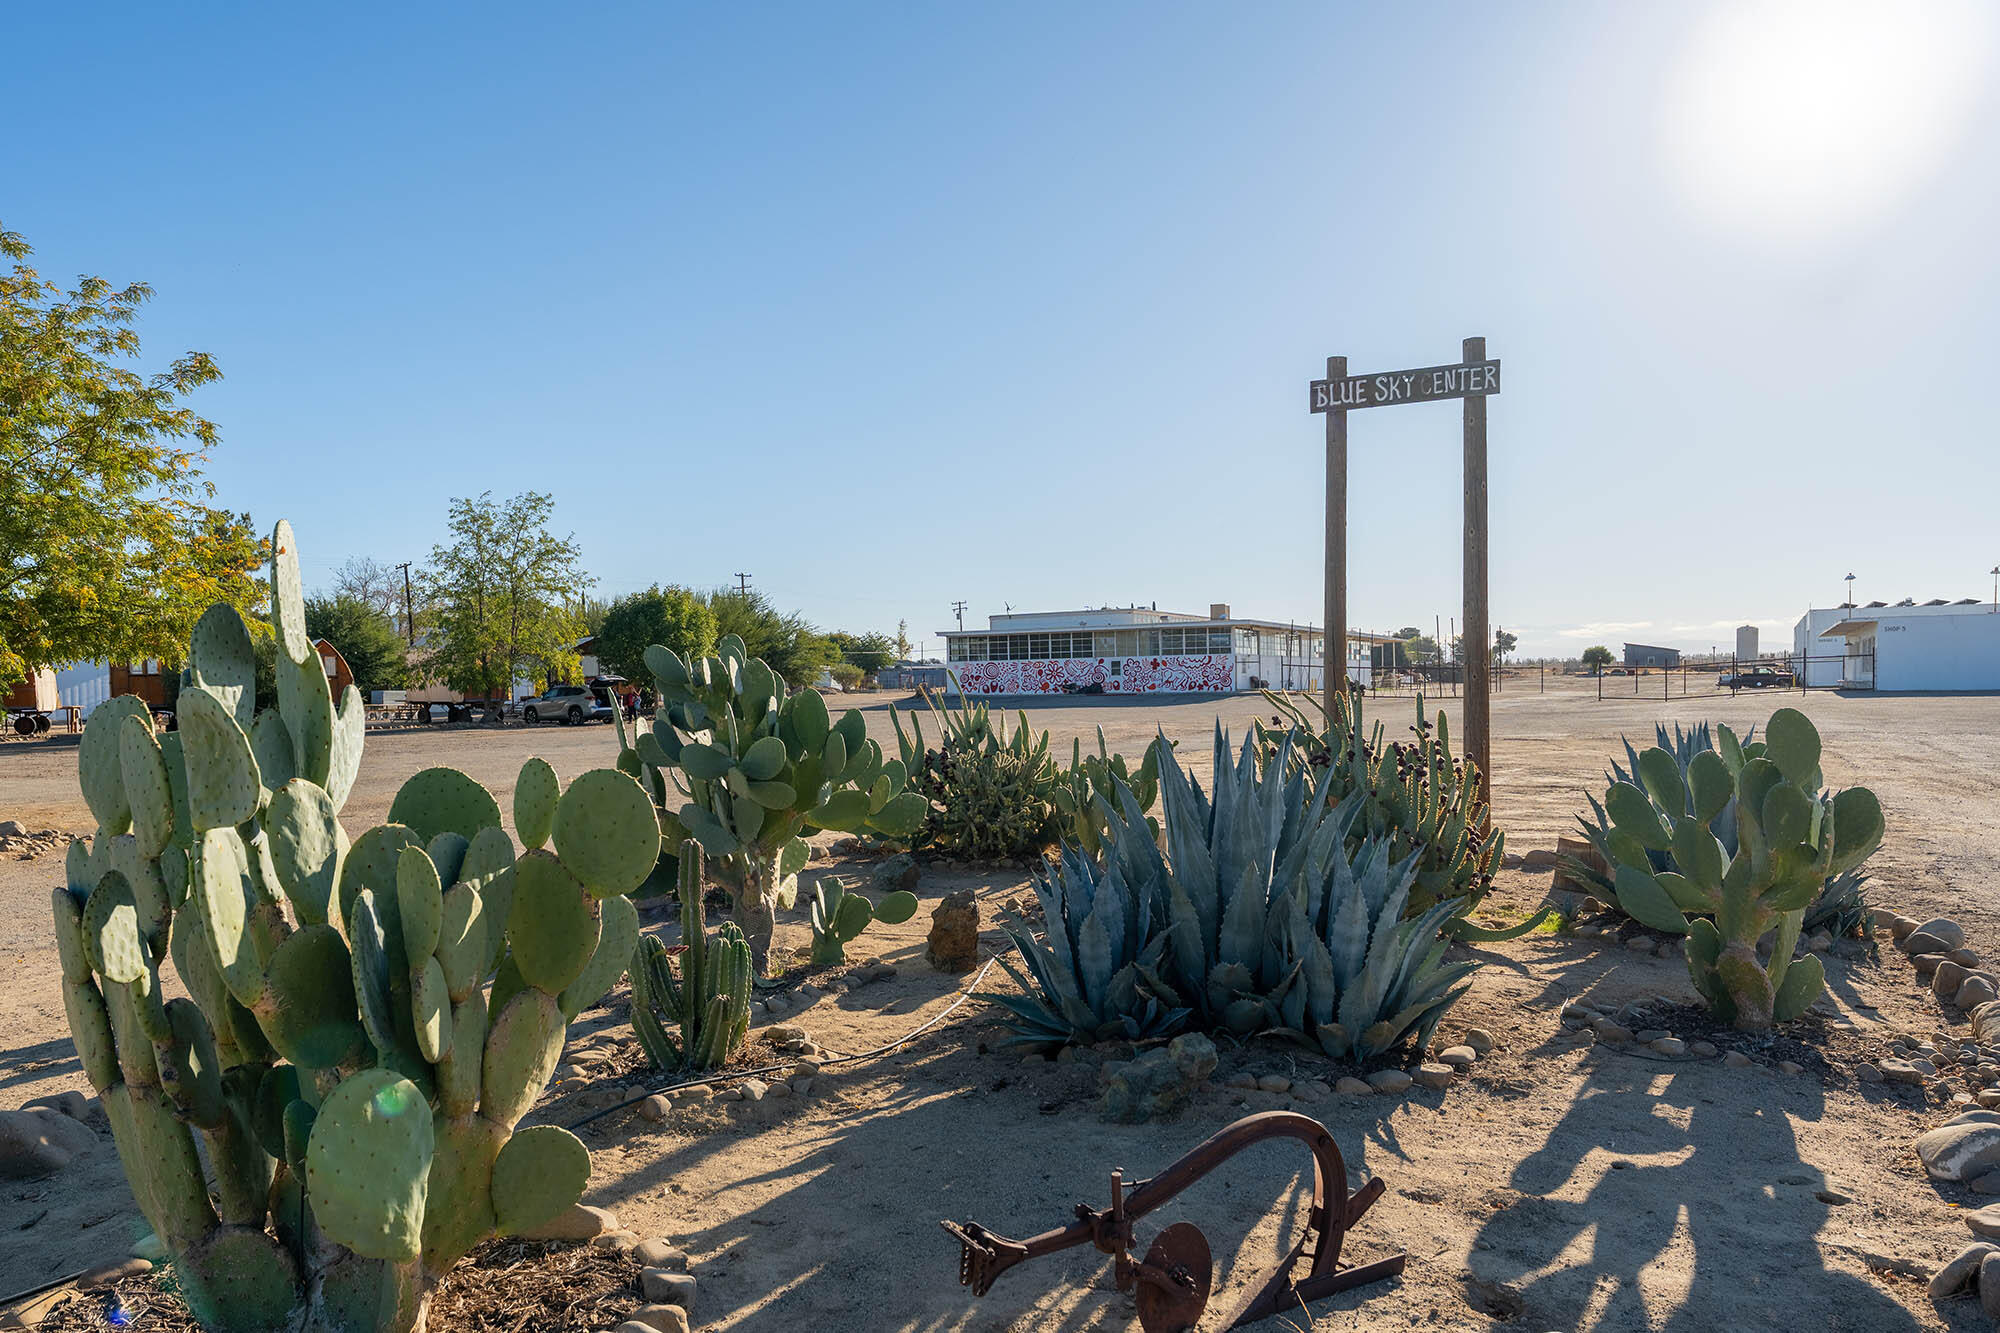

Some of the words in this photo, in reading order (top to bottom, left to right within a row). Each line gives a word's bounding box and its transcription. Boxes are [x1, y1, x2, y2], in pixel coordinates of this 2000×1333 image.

[1314, 380, 1367, 407] BLUE
[1375, 374, 1415, 401] SKY
[1421, 366, 1496, 395] CENTER
